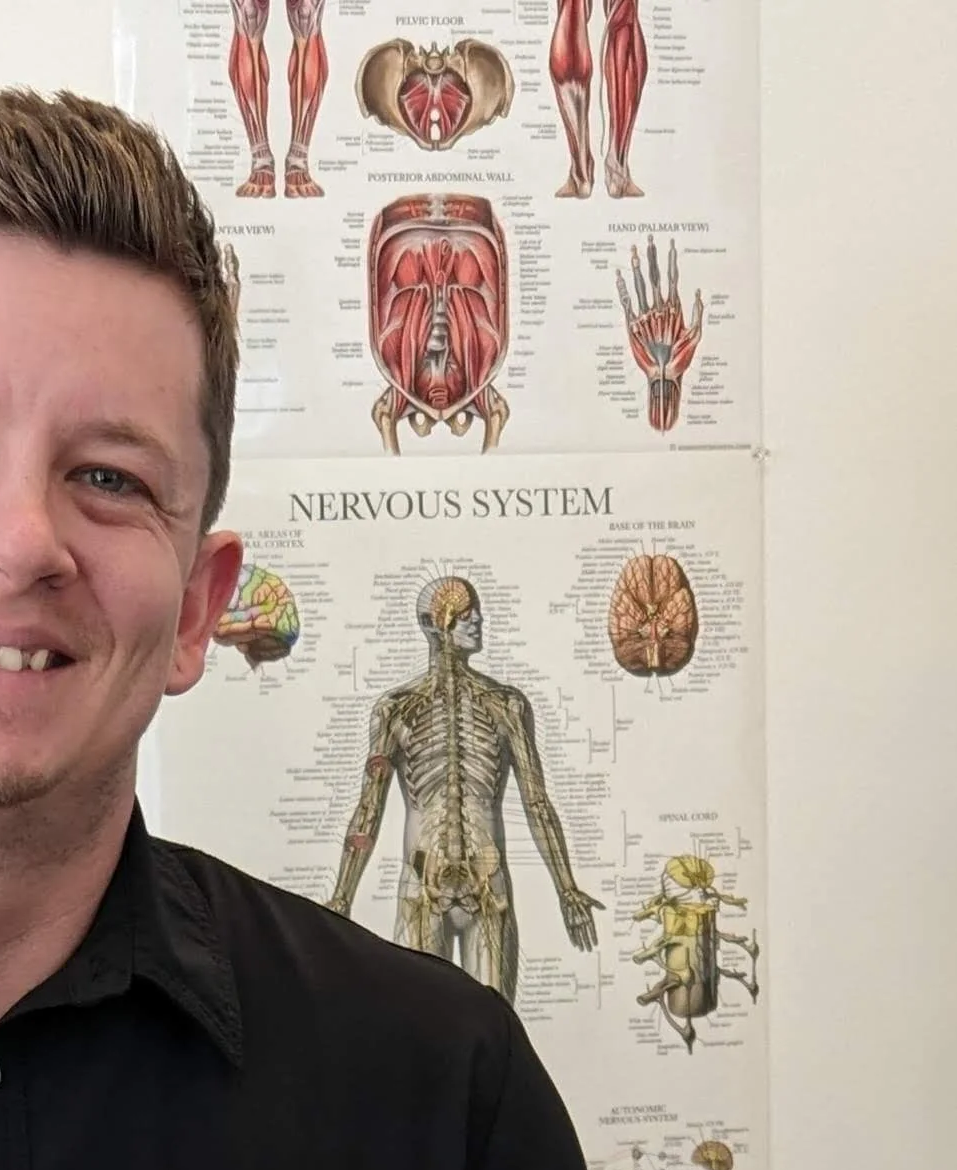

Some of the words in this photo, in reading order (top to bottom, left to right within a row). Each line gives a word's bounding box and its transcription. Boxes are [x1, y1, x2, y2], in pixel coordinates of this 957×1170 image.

[396, 15, 429, 26] PELVIC
[430, 15, 465, 26] FLOOR
[367, 172, 423, 183] POSTERIOR
[425, 172, 484, 183] ABDOMINAL
[486, 172, 515, 183] WALL
[245, 225, 275, 236] VIEW)
[608, 223, 637, 233] HAND
[638, 223, 680, 233] (PALMAR
[681, 222, 710, 233] VIEW)
[288, 489, 462, 522] NERVOUS
[472, 486, 614, 518] SYSTEM
[609, 522, 631, 531] BASE
[632, 522, 643, 531] OF
[647, 521, 665, 530] THE
[667, 520, 696, 530] BRAIN
[658, 812, 690, 822] SPINAL
[691, 811, 719, 821] CORD
[610, 1104, 667, 1115] AUTONOMIC
